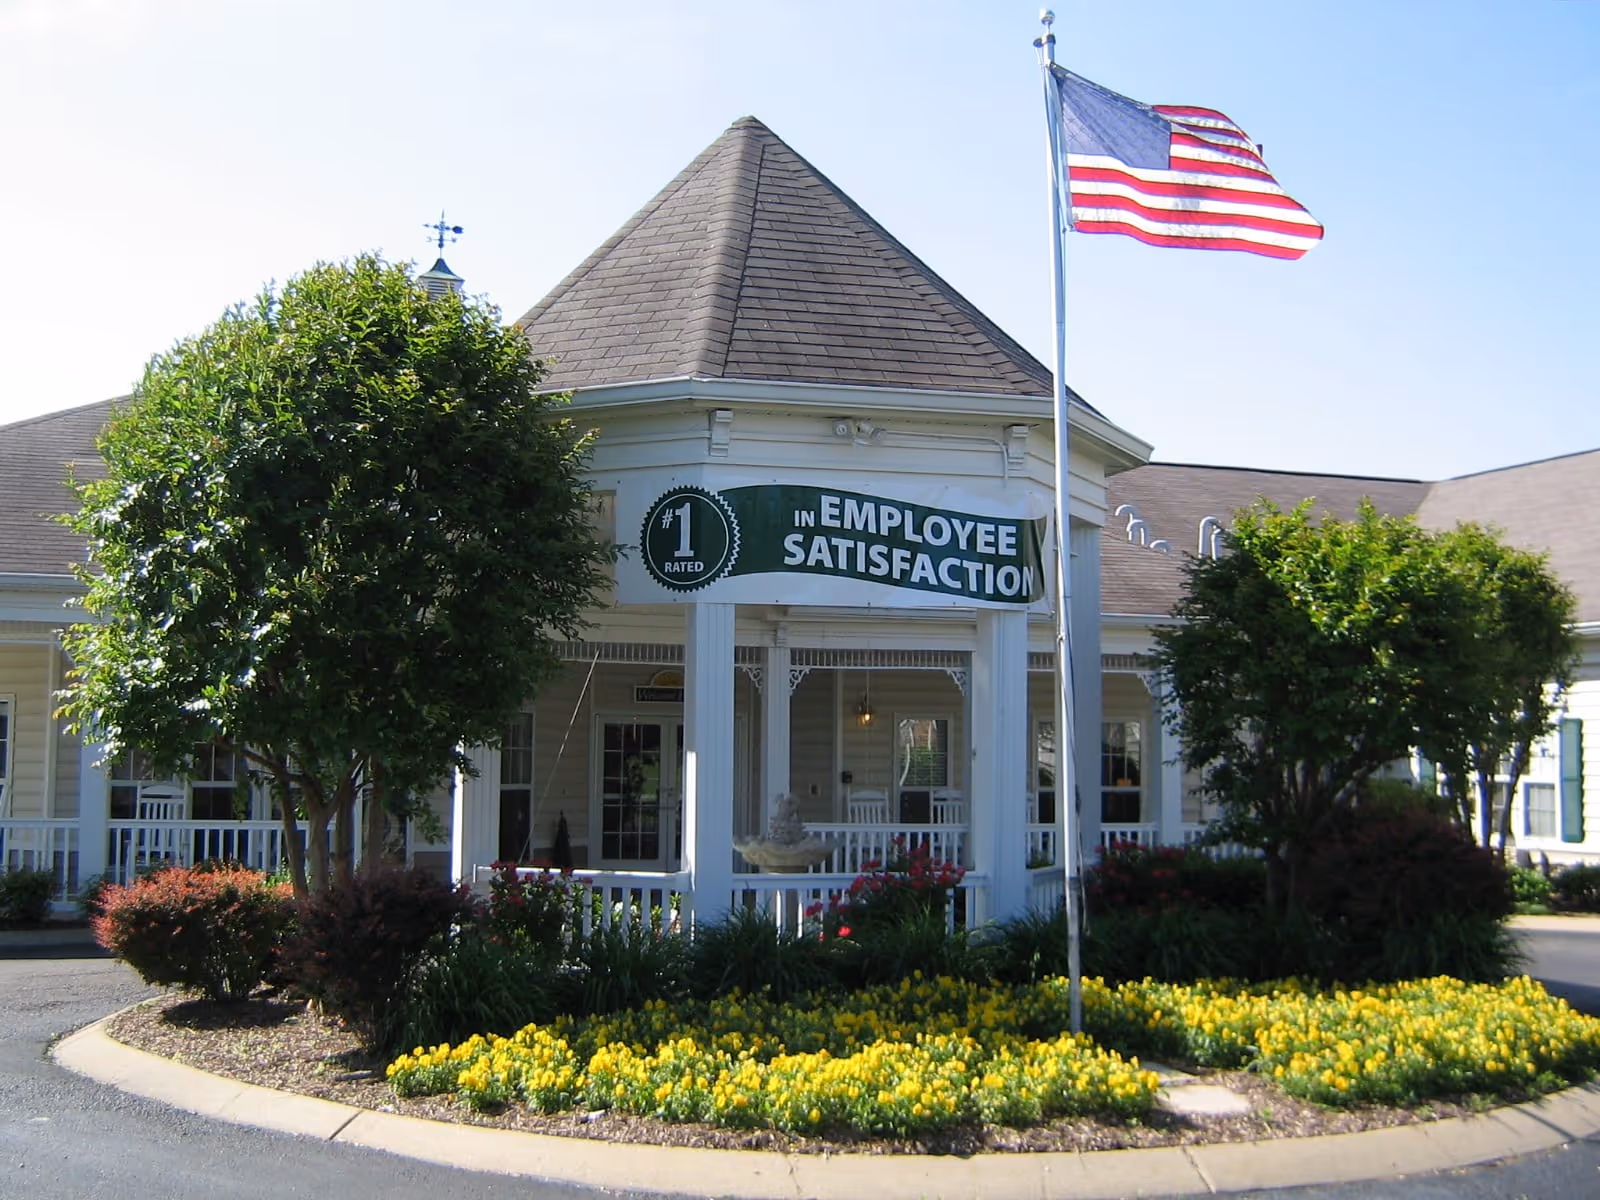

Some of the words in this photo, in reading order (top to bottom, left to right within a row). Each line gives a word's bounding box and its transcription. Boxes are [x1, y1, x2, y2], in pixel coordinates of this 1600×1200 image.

[661, 501, 696, 558] #1
[793, 509, 815, 528] IN
[820, 494, 1017, 556] EMPLOYEE
[664, 560, 704, 573] RATED
[783, 534, 1034, 597] SATISFACTION
